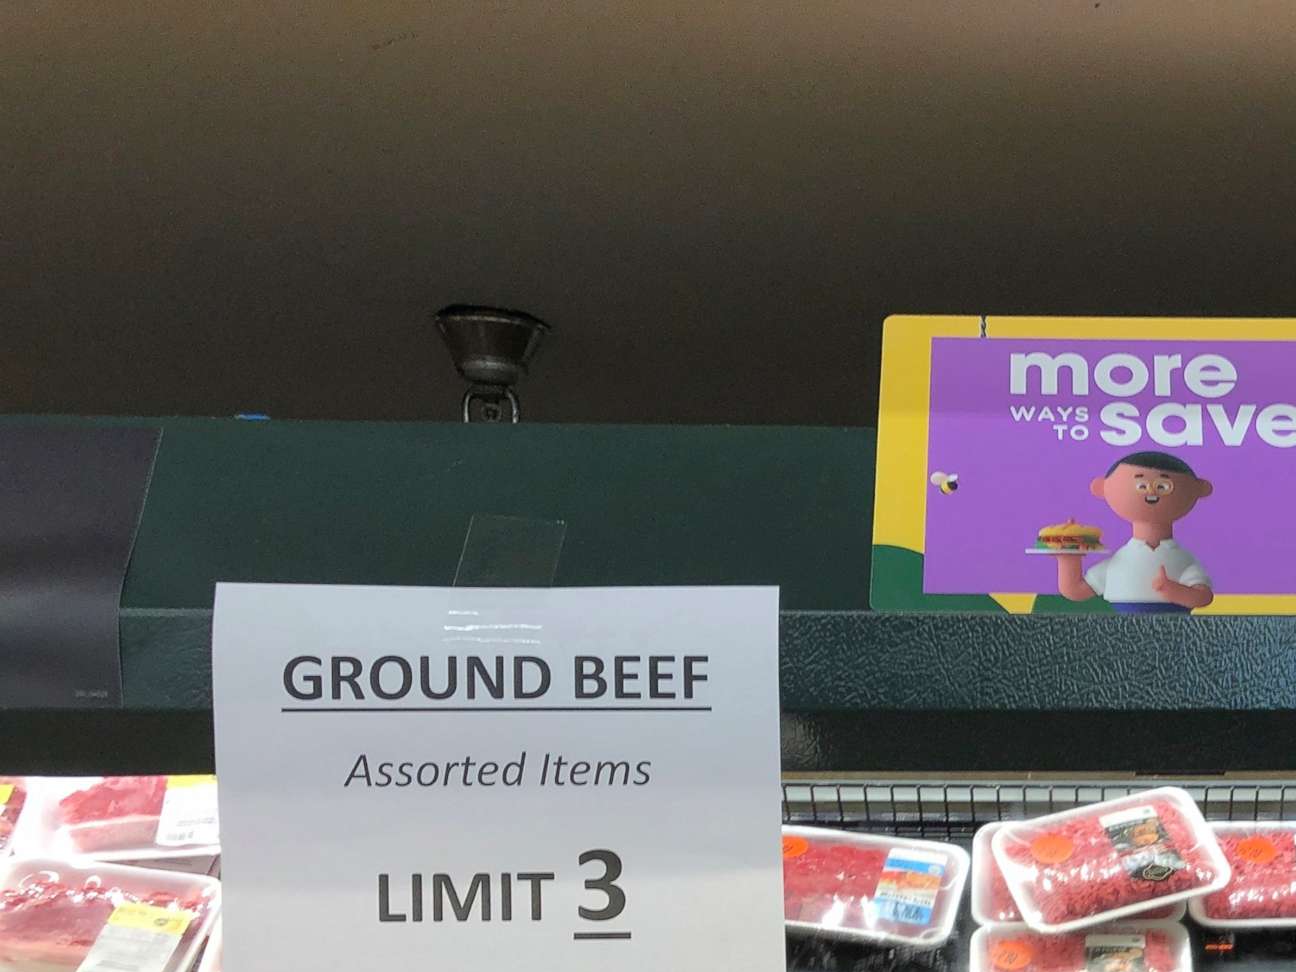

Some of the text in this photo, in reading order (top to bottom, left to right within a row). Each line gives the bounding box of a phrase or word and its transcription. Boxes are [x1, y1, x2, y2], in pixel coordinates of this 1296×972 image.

[1009, 351, 1238, 398] more
[1010, 406, 1088, 423] WAYS
[1054, 424, 1088, 441] TO
[282, 655, 710, 701] GROUND BEEF
[344, 751, 652, 787] Assorted Items
[378, 848, 627, 922] LIMIT 3
